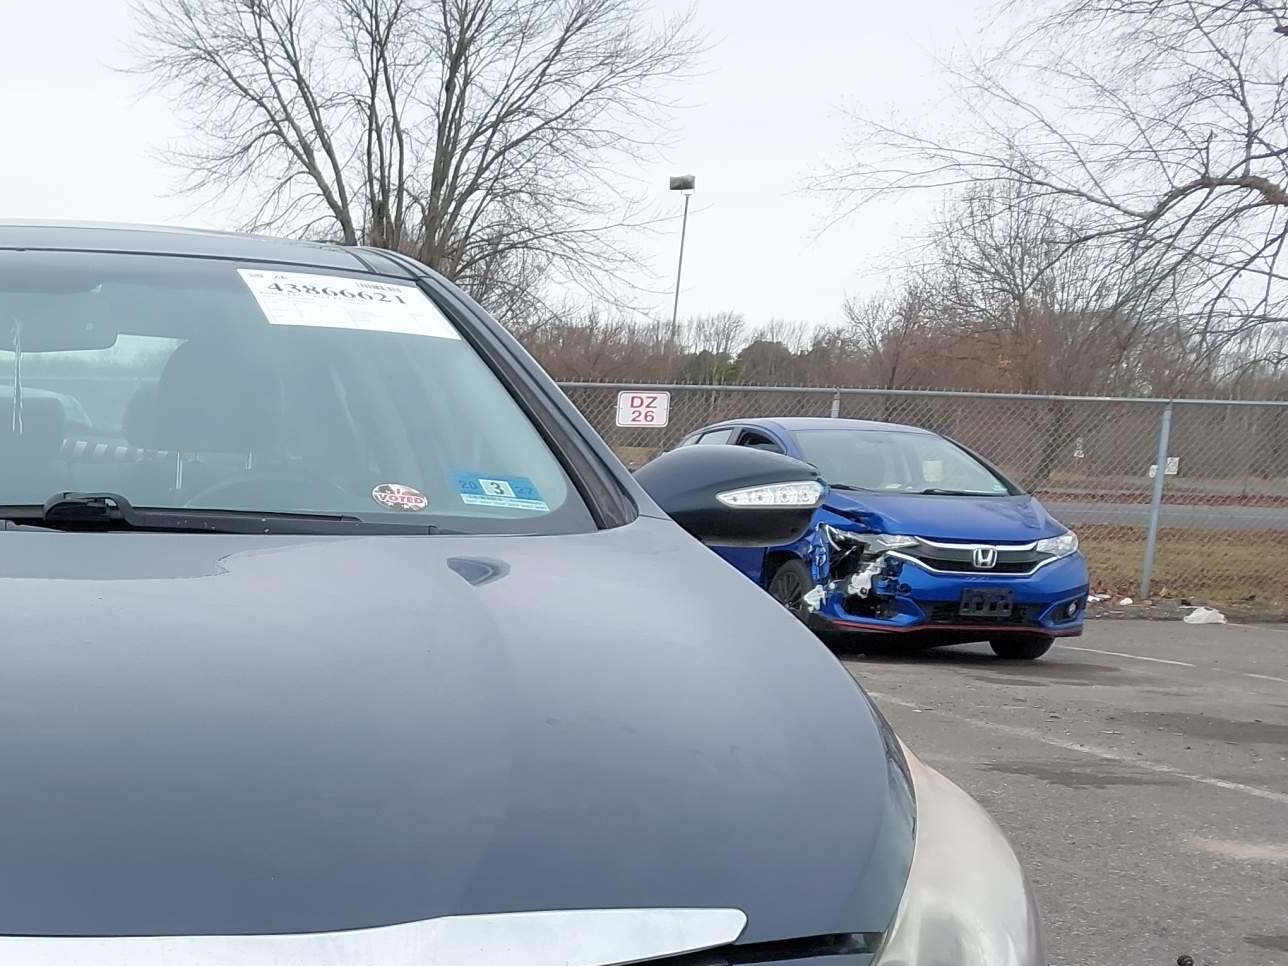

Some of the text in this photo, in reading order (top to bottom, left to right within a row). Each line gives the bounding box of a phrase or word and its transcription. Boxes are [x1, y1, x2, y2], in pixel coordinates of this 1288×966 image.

[267, 282, 407, 305] 43866621
[630, 395, 658, 409] DZ
[631, 410, 655, 423] 26
[490, 482, 505, 495] 3
[378, 494, 423, 504] VOTED
